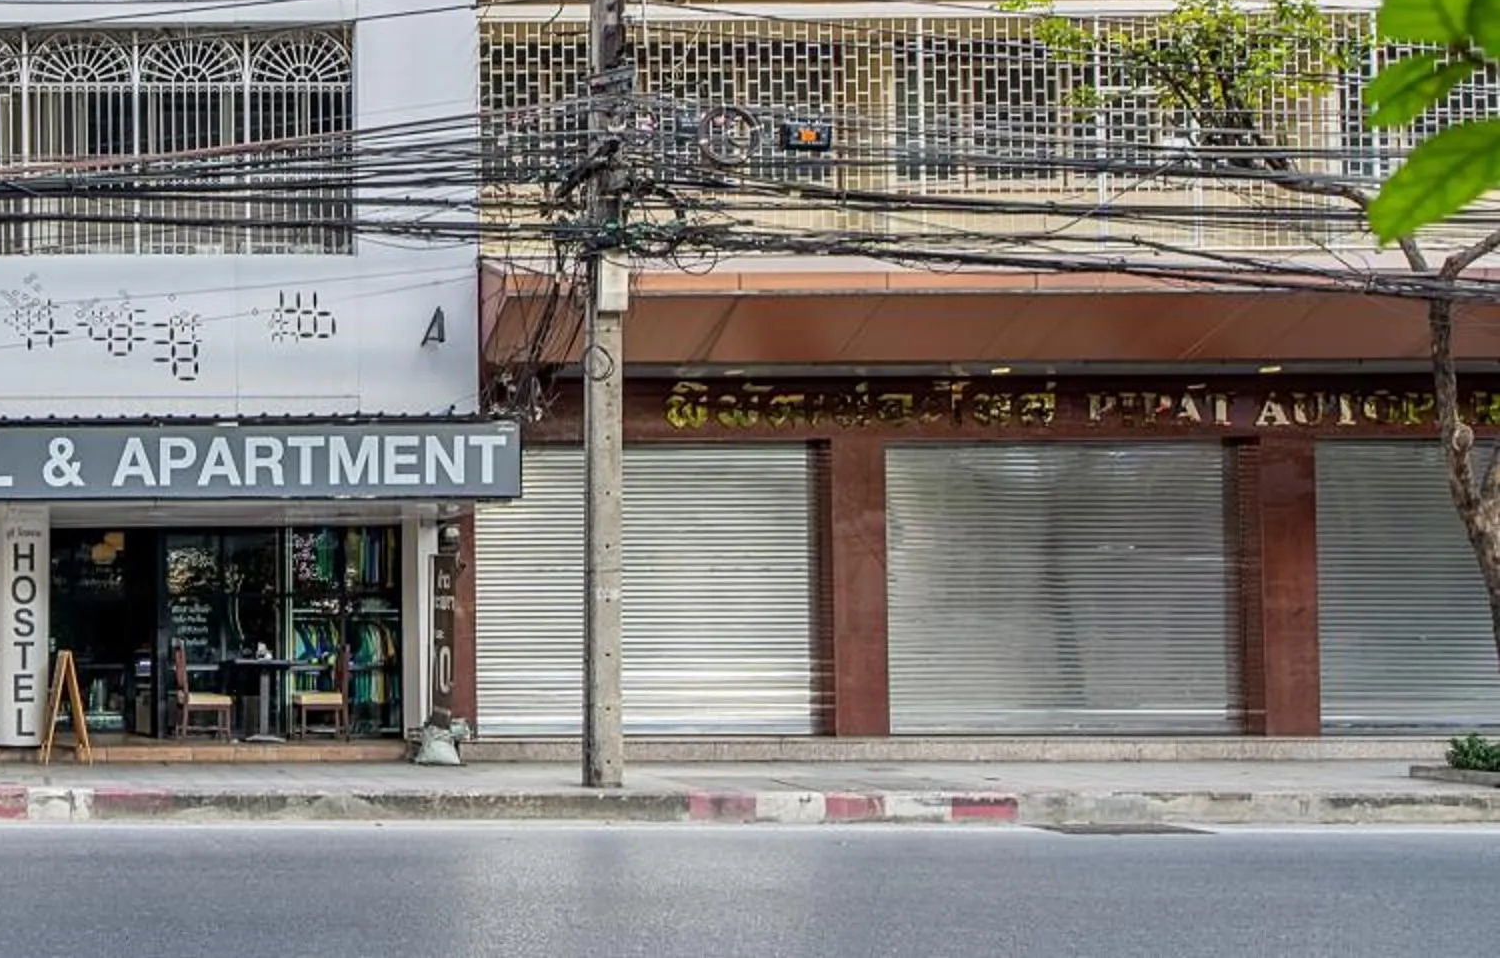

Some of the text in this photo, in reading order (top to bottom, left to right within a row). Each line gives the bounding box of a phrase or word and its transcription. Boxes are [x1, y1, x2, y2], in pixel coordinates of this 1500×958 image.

[43, 436, 85, 488] &
[112, 435, 508, 487] APARTMENT
[11, 542, 36, 739] HOSTEL
